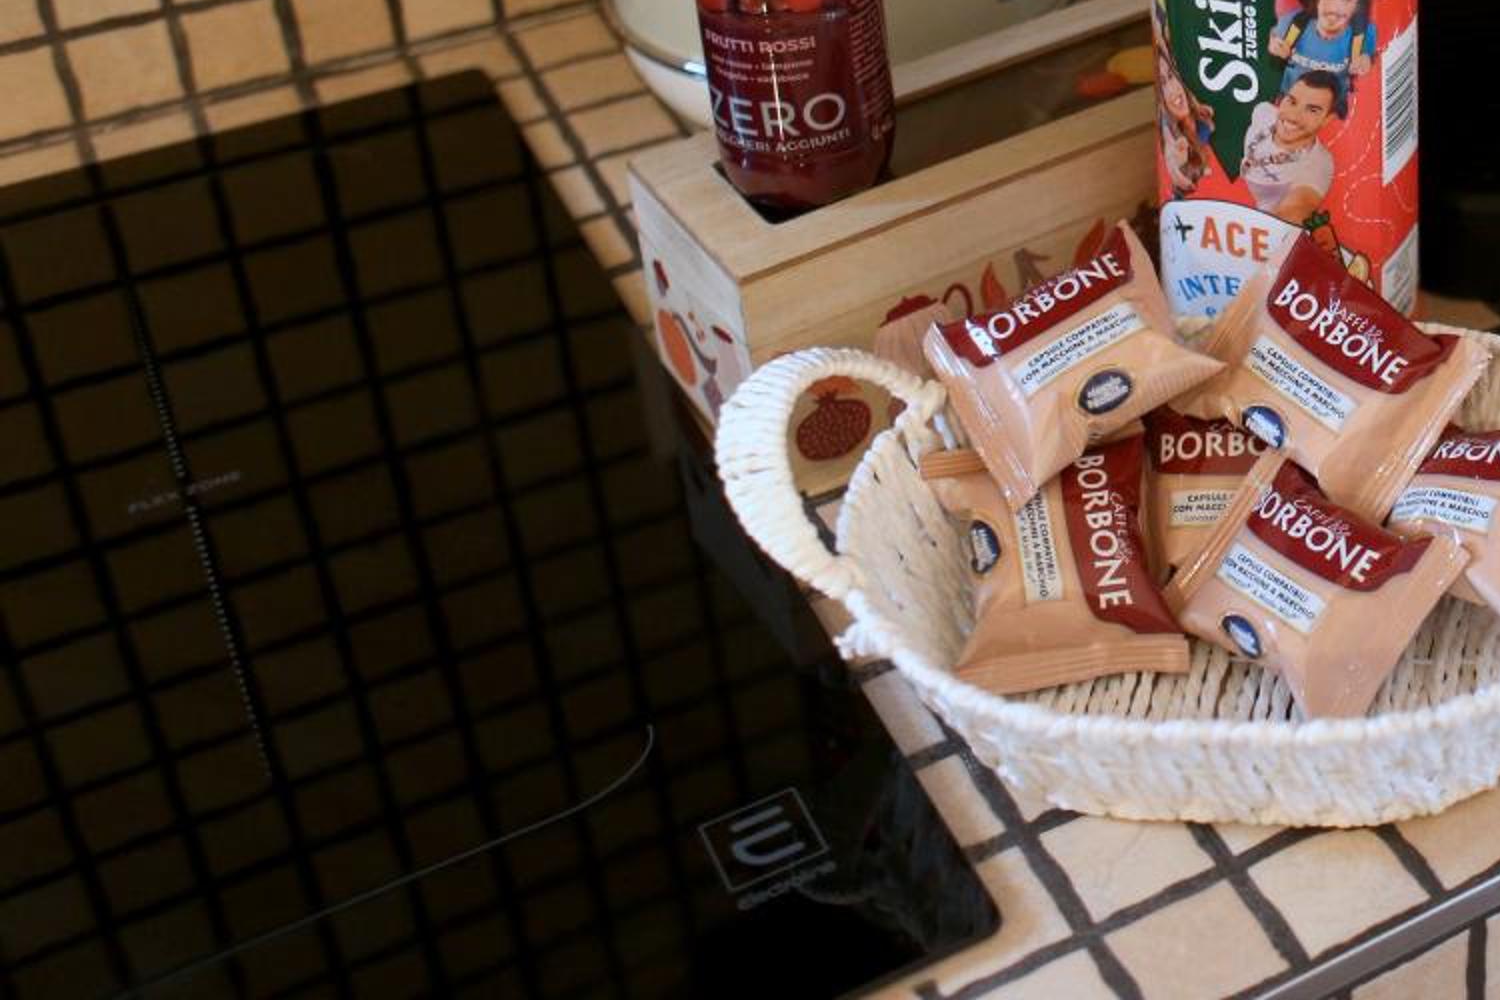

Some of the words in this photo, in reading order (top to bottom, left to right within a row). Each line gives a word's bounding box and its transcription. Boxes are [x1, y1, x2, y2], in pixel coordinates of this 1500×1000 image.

[759, 35, 817, 54] ROSSI
[710, 86, 847, 138] ZERO
[1201, 216, 1271, 263] ACE
[1273, 278, 1409, 386] BORBONE
[1072, 454, 1135, 610] BORBONE
